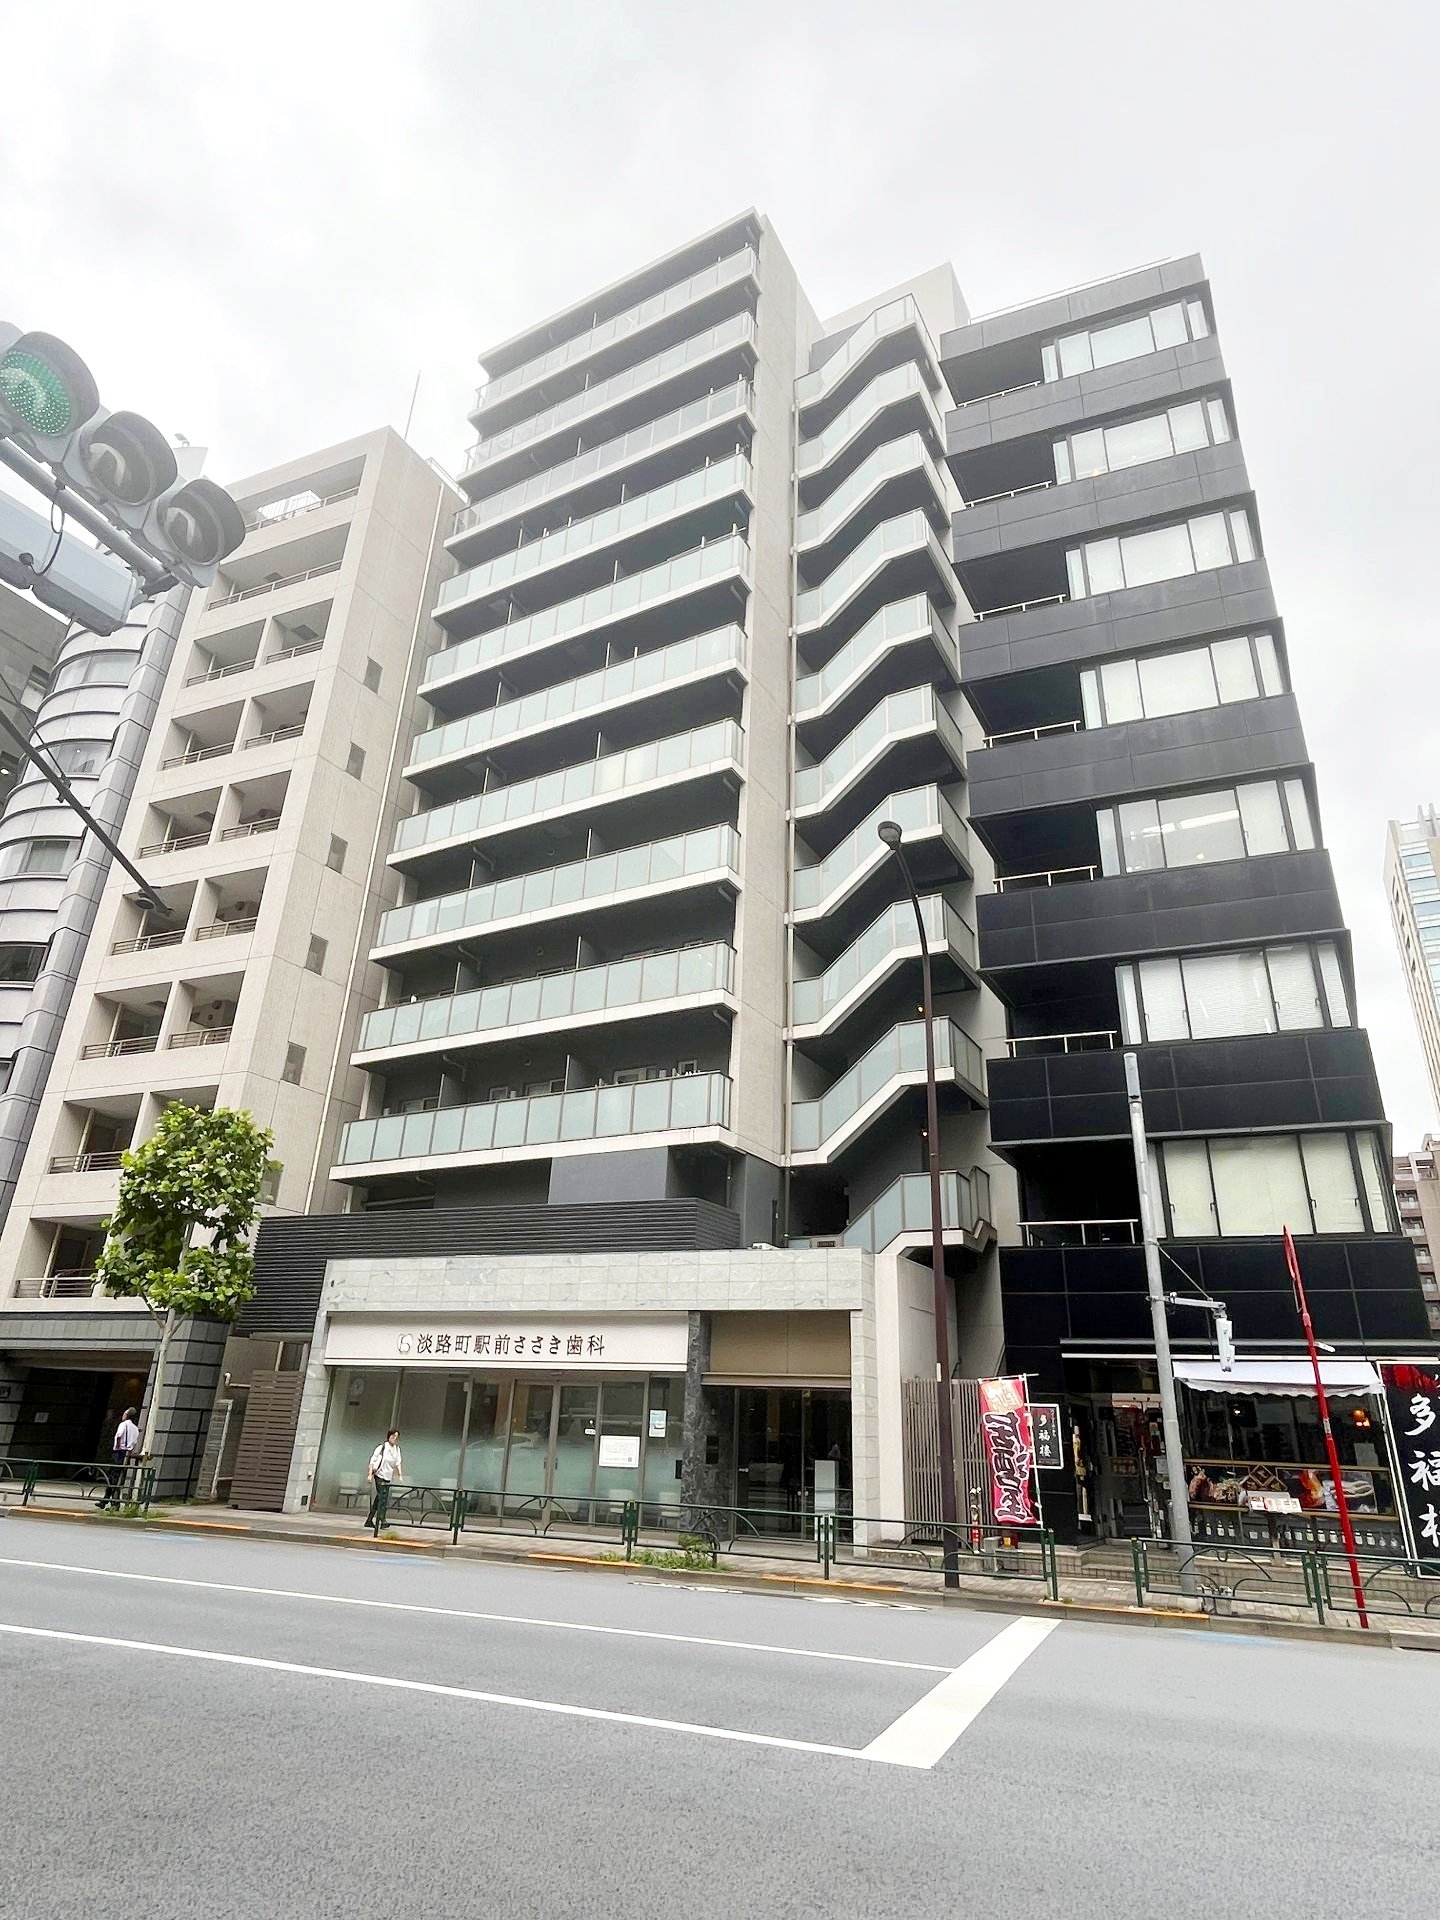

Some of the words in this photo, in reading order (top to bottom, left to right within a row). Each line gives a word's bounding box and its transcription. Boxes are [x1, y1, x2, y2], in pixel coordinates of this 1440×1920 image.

[417, 1333, 605, 1356] 淡路町駅前ささき歯科
